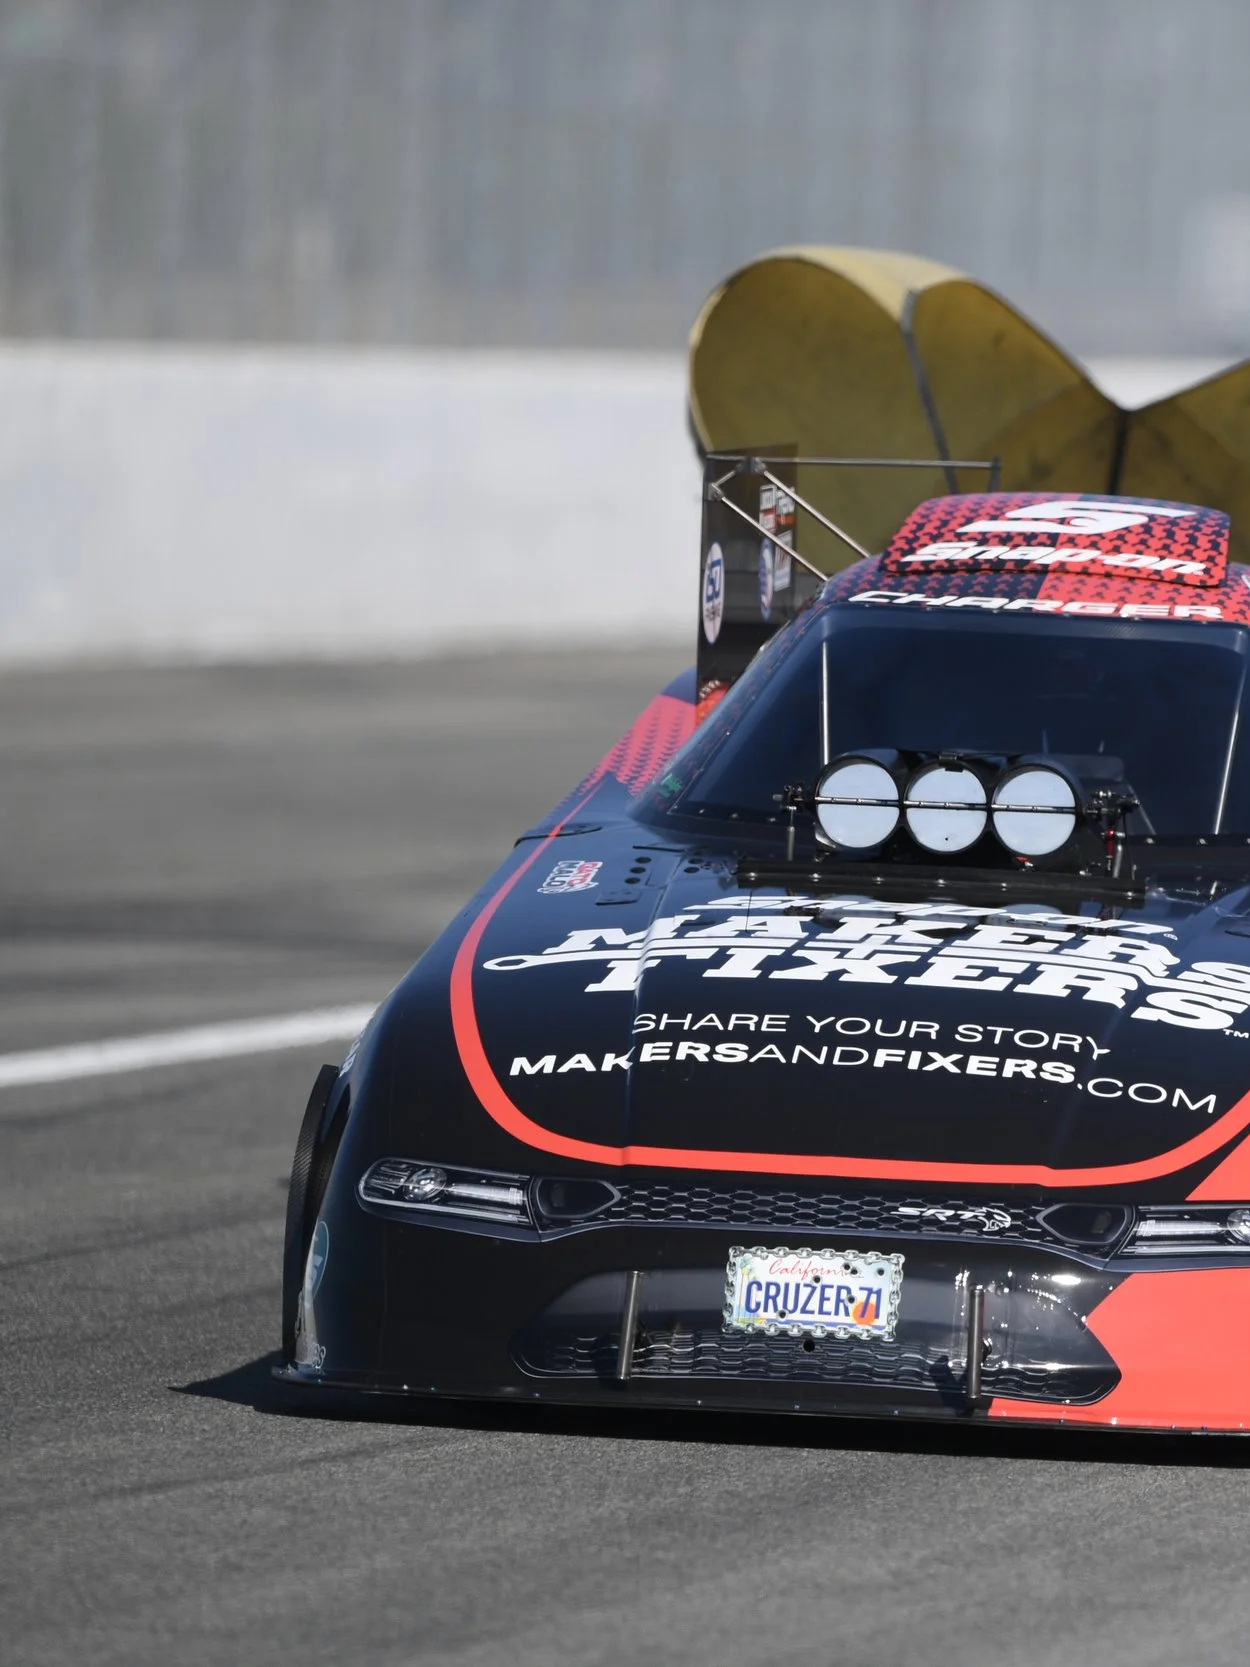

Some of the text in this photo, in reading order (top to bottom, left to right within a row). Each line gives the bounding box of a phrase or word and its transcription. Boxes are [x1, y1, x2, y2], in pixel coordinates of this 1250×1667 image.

[901, 541, 1207, 575] Snap-on
[848, 590, 1224, 618] CHARGER
[583, 946, 1249, 1031] FIXERS
[633, 1012, 1111, 1061] SHARE YOUR STORY
[509, 1041, 1218, 1114] MAKERSANDFIXERS.COM
[890, 1206, 986, 1221] SRT
[768, 1258, 861, 1281] Californi
[744, 1280, 884, 1320] CRUZER 71
